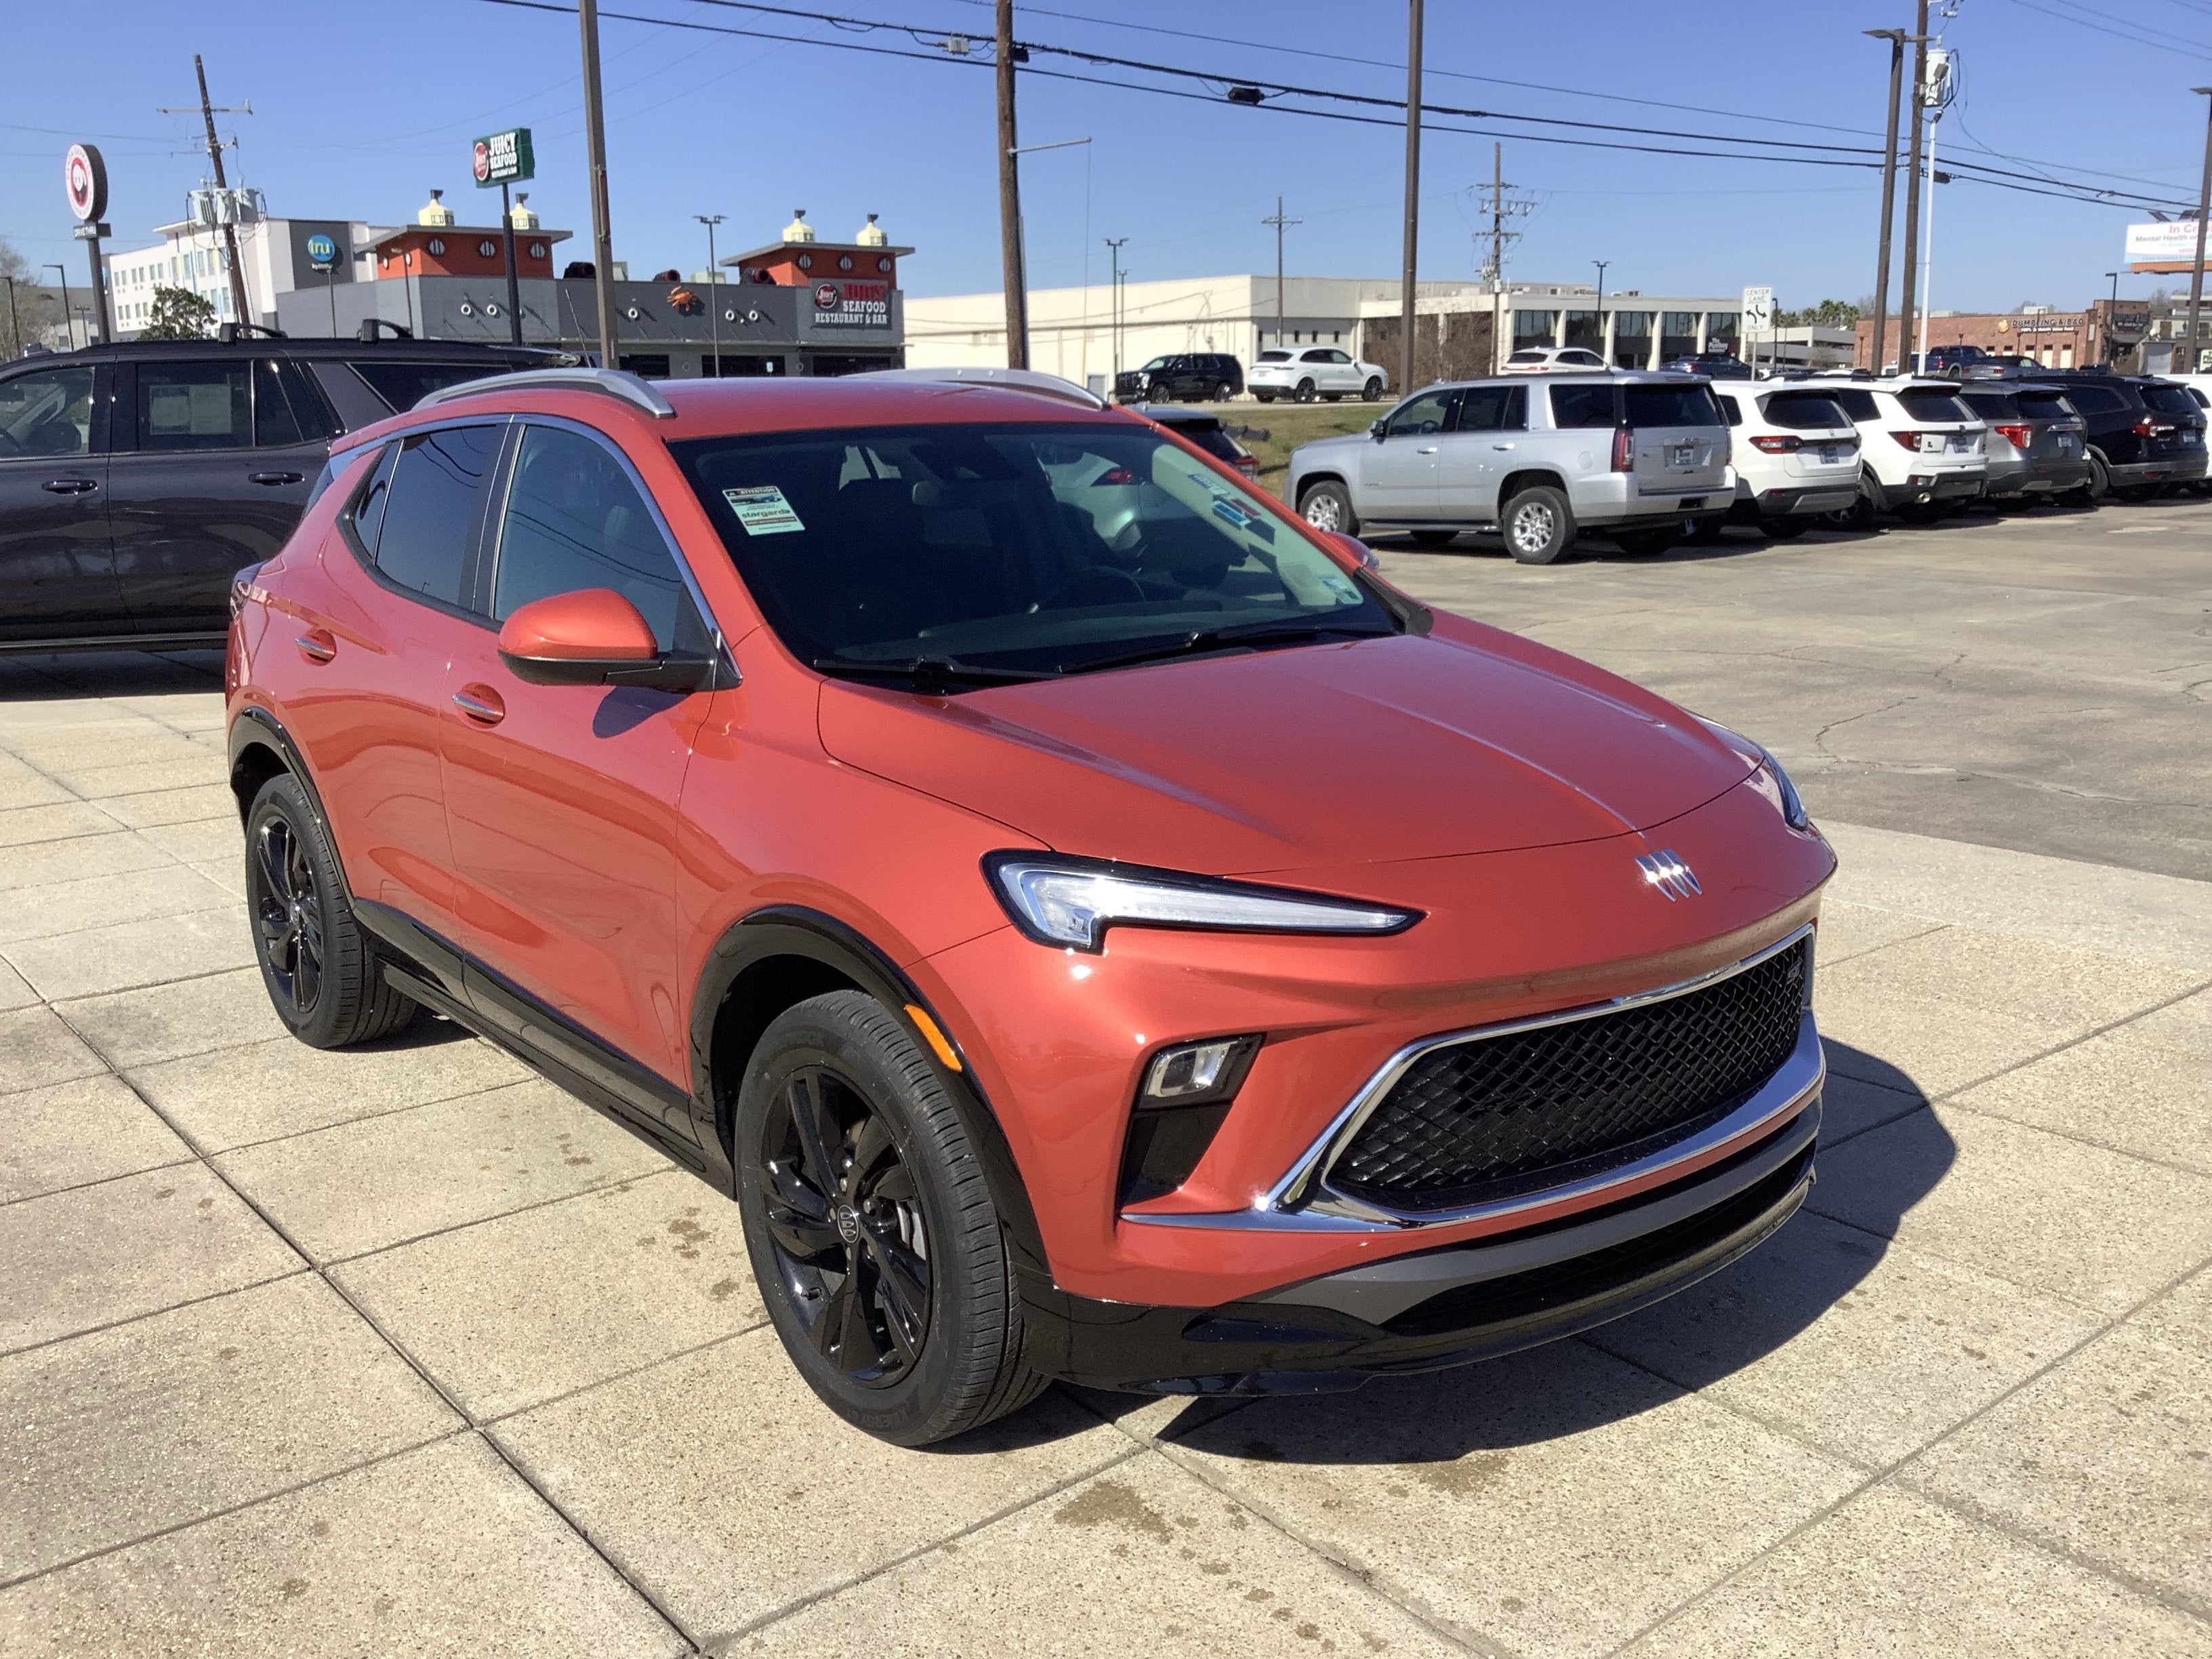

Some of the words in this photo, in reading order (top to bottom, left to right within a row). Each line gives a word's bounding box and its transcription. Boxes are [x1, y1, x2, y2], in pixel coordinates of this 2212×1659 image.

[489, 132, 516, 157] JUICY
[489, 151, 517, 169] SEAFOOD
[2169, 224, 2181, 234] In
[307, 239, 331, 254] tru
[842, 300, 886, 313] SEAFOOD
[815, 312, 864, 323] RESTAURANT
[865, 314, 871, 324] &
[872, 314, 888, 325] BAR
[2066, 317, 2085, 325] BAO
